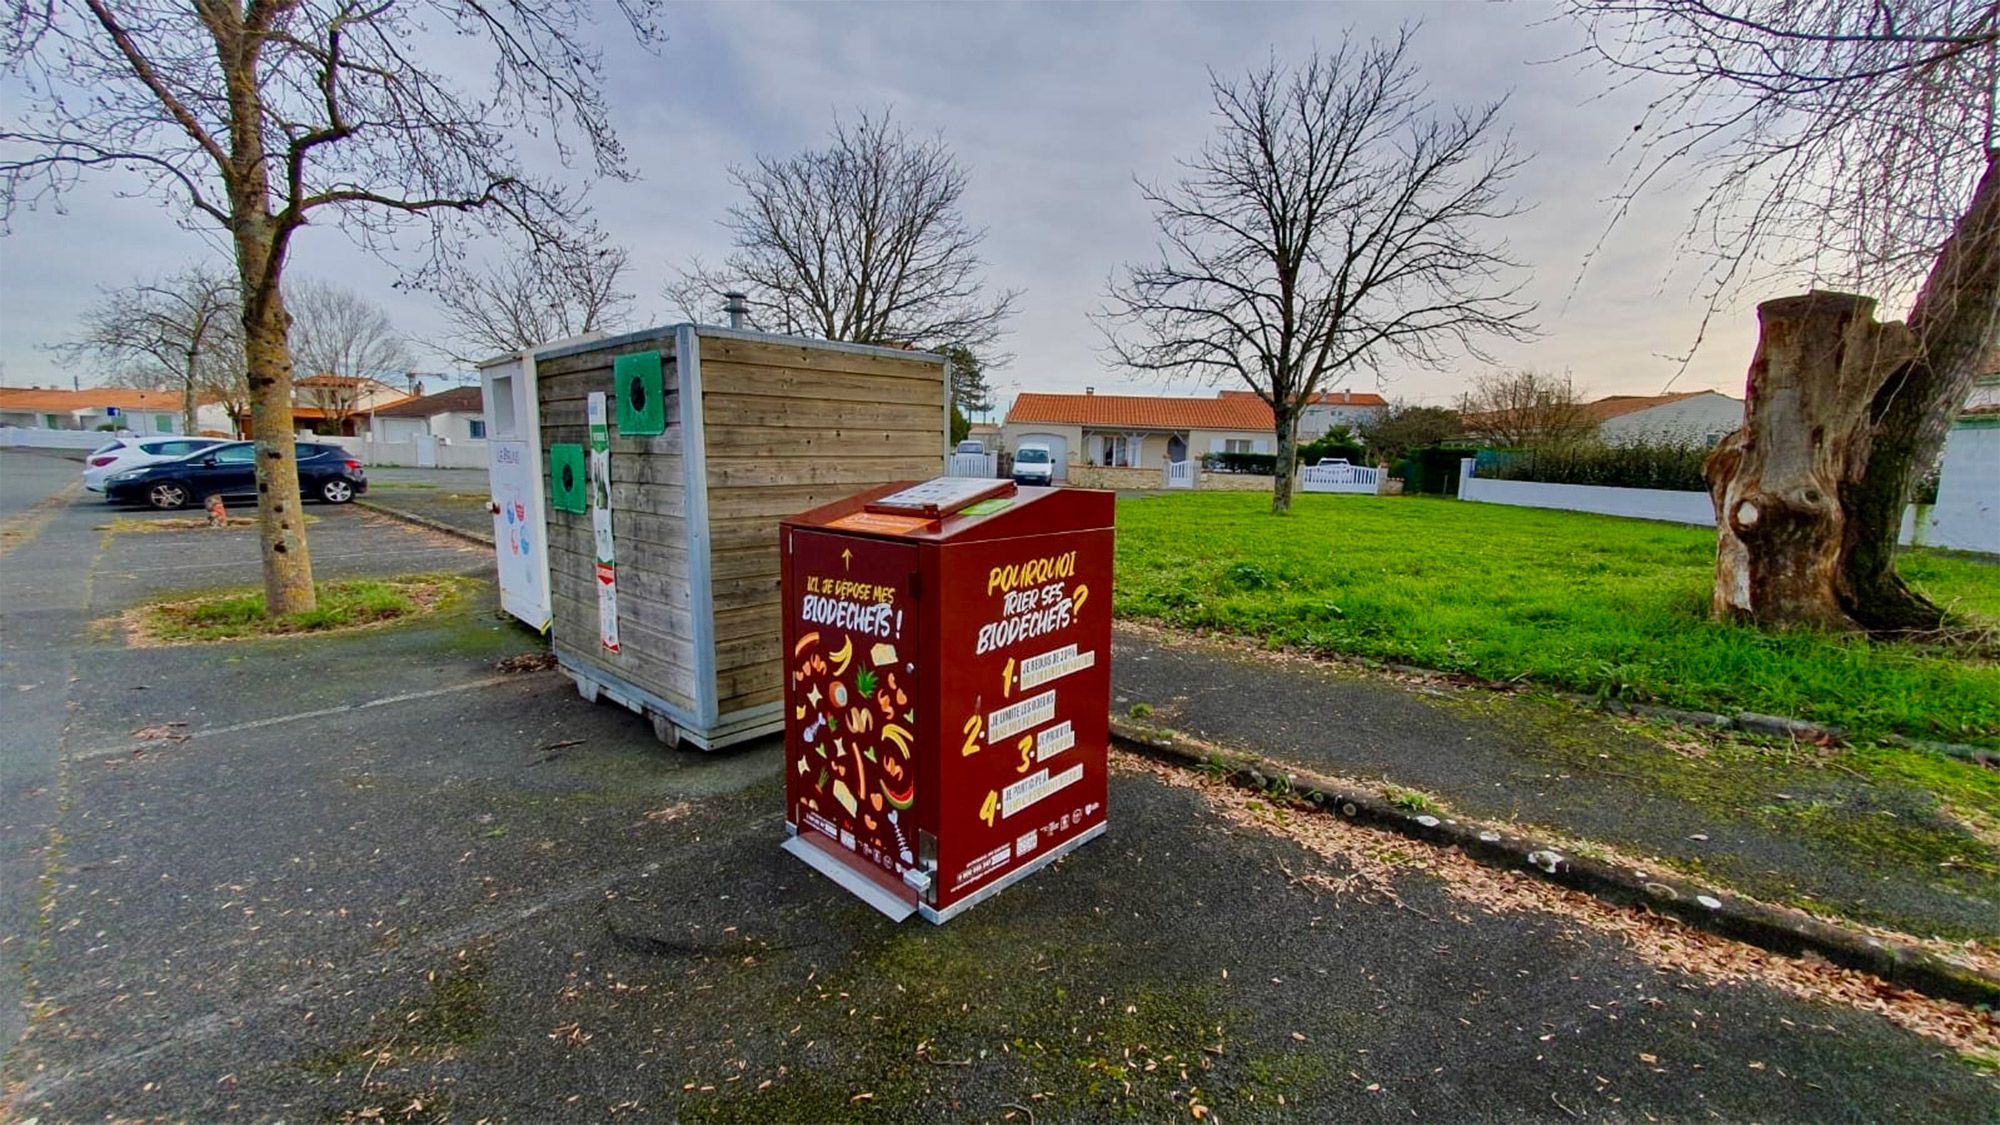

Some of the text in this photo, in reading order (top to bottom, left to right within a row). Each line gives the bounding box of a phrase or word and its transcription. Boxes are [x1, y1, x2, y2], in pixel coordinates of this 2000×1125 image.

[835, 578, 872, 601] DÉPOSE
[873, 585, 896, 605] MES
[988, 550, 1077, 596] POURQUOI
[802, 594, 903, 639] BIODÉCHETS !
[1003, 581, 1065, 618] TRIER SES
[975, 598, 1073, 655] BIODÉCHETS
